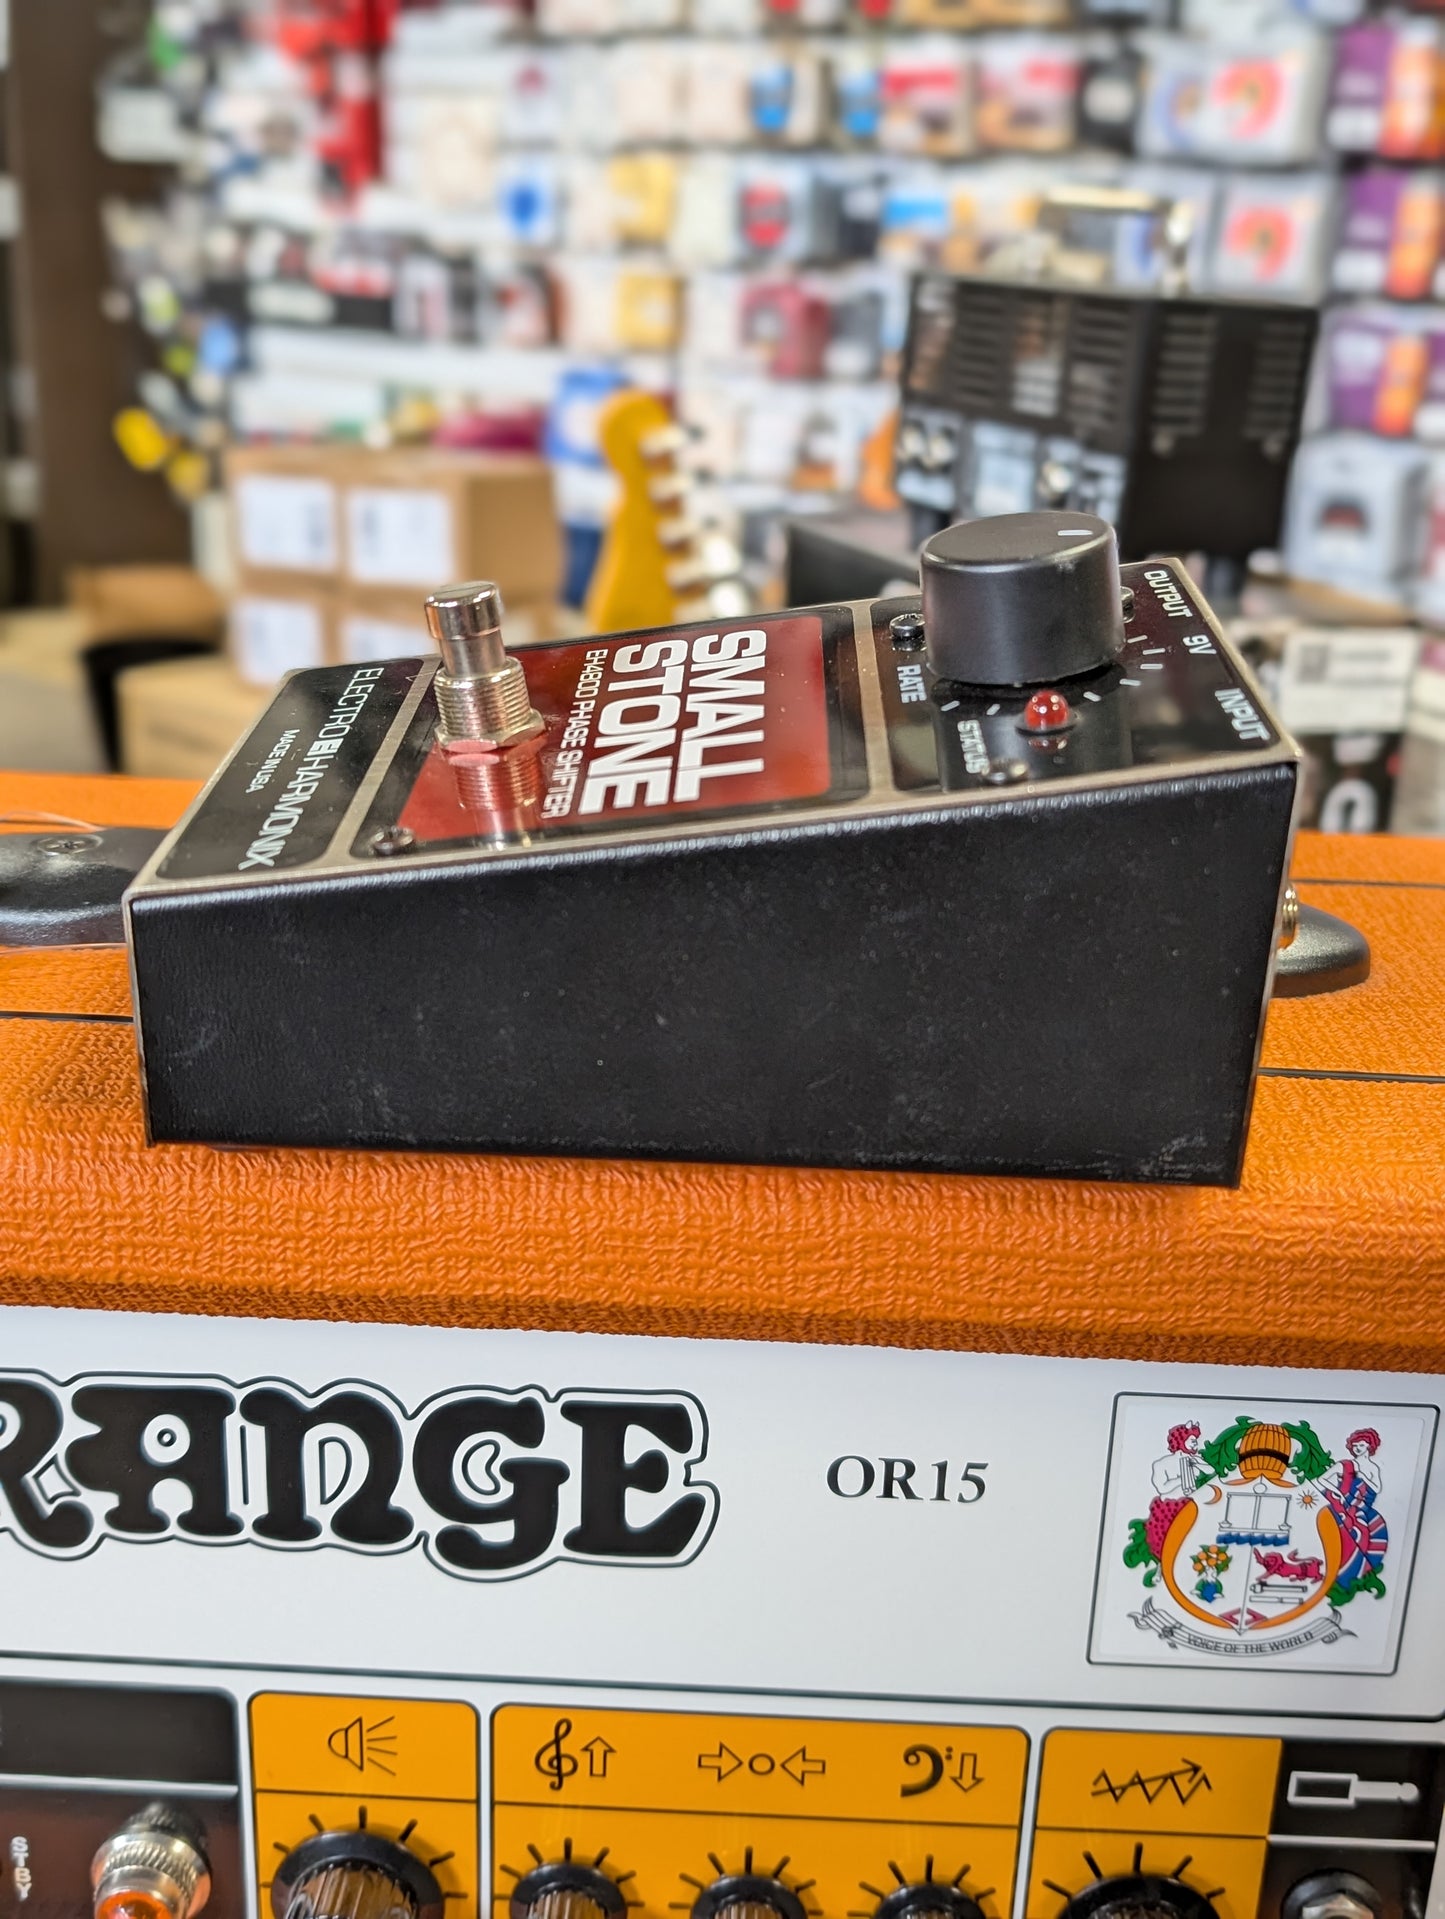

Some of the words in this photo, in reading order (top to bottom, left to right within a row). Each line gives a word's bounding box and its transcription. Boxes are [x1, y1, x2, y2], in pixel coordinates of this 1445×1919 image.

[1143, 569, 1193, 618] OUTPUT
[1182, 634, 1217, 655] 9V
[574, 649, 608, 699] EH4800
[896, 664, 927, 704] RATE
[560, 699, 596, 749] PHASE
[577, 639, 688, 815] STONE
[673, 629, 767, 801] SMALL
[1214, 688, 1271, 741] INPUT
[261, 757, 282, 770] IN
[268, 729, 300, 759] MADE
[957, 719, 990, 776] STATUS
[245, 769, 274, 793] USA
[541, 749, 583, 819] SHIFTER
[826, 1454, 989, 1504] OR15
[1187, 1632, 1221, 1652] VOICE
[1223, 1643, 1240, 1654] OF
[1242, 1643, 1266, 1654] THE
[1267, 1630, 1314, 1652] WORLD
[11, 1836, 33, 1901] STBY
